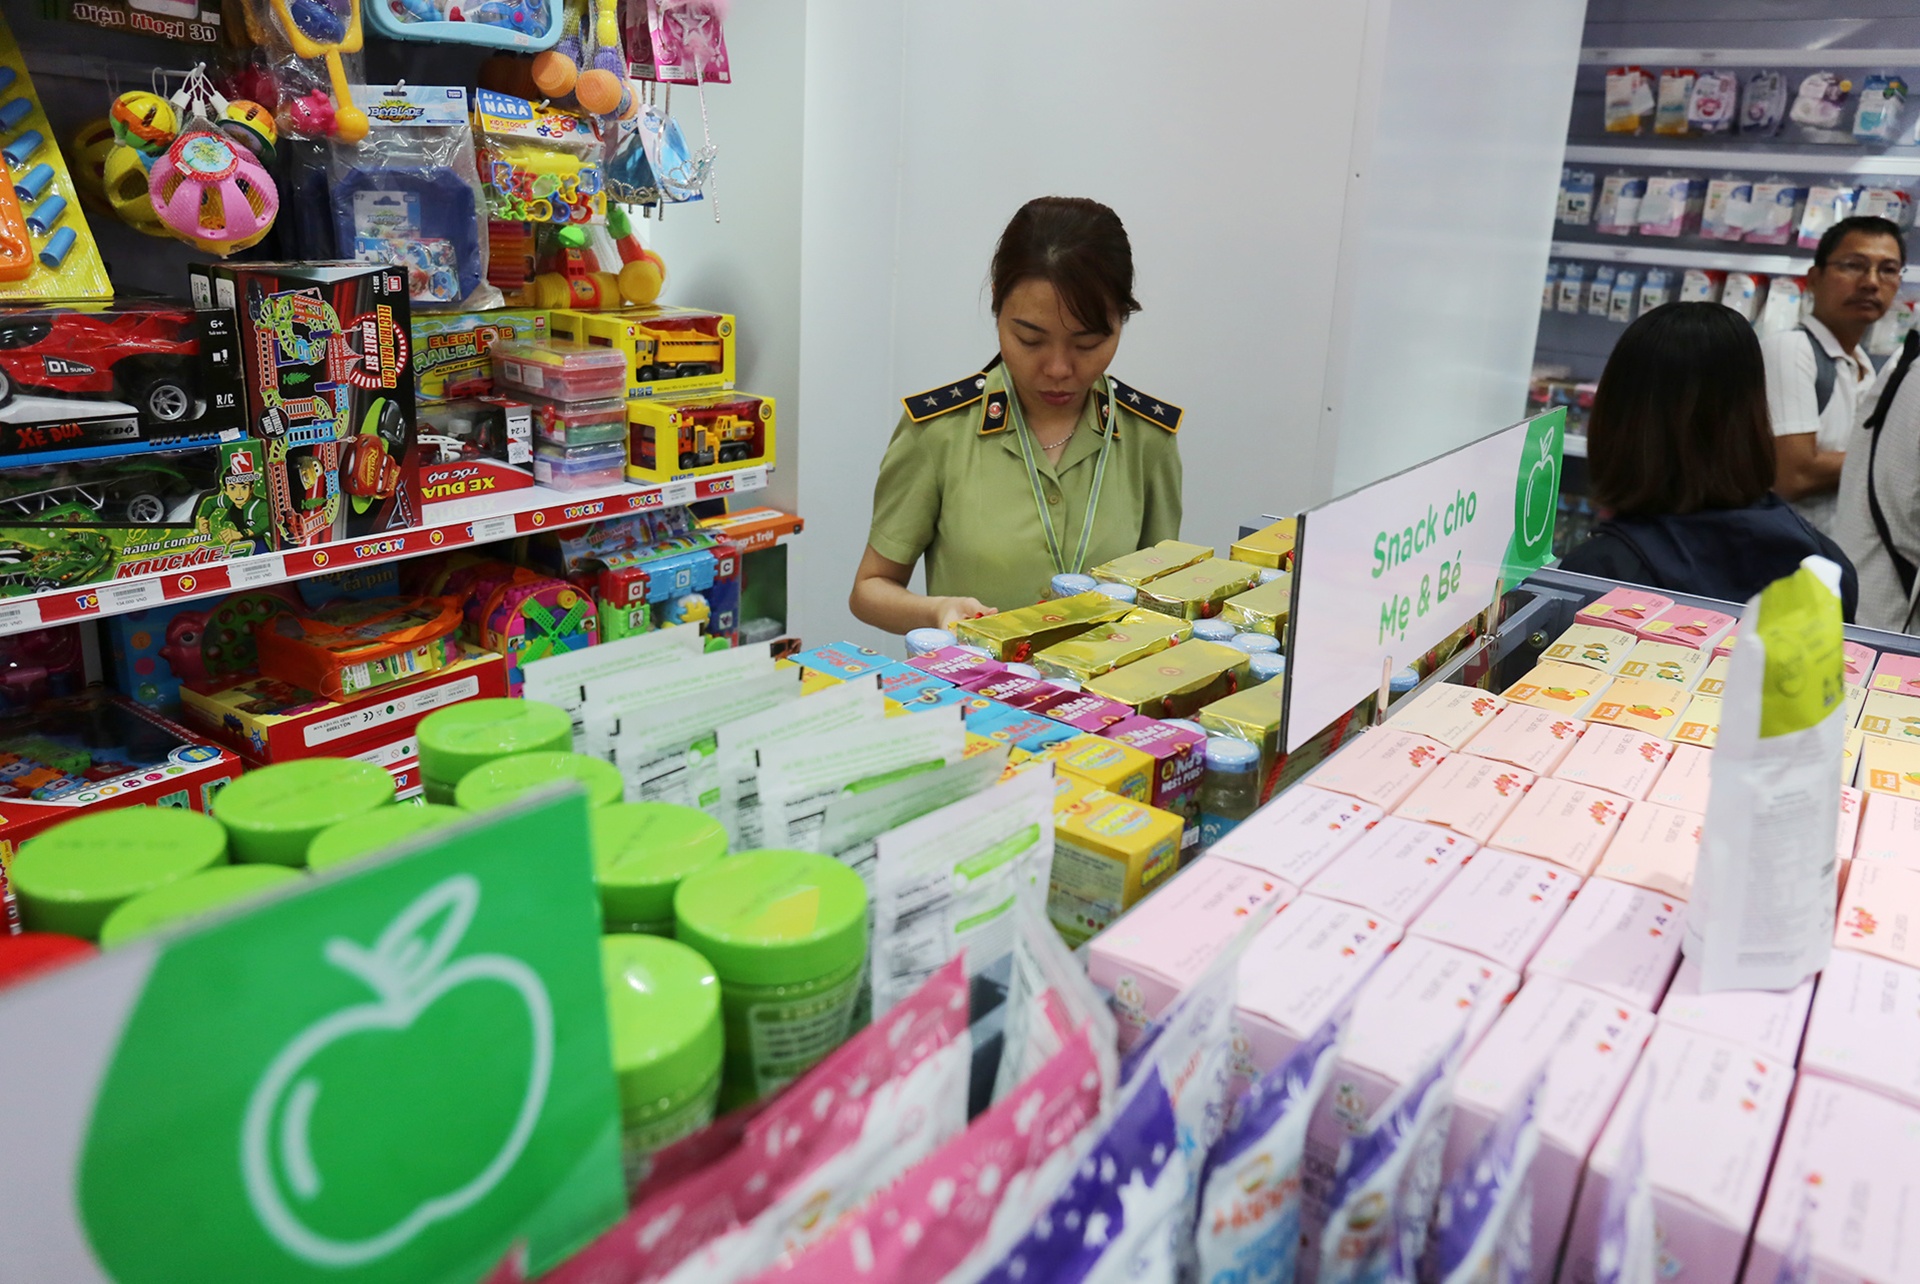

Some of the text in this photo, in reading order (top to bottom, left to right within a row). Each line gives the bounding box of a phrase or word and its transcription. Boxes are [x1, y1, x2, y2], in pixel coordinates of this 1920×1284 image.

[189, 24, 216, 41] 3D
[368, 106, 424, 116] BEYBLADE
[485, 100, 529, 116] NARA
[489, 119, 528, 129] KIDS TOOLS
[210, 320, 224, 329] 6+
[377, 304, 394, 346] ELECTRIC
[362, 321, 379, 371] CREATE SET
[382, 368, 397, 389] CAR
[216, 394, 235, 405] R/C
[16, 427, 47, 449] XE
[511, 426, 527, 435] 1:24
[469, 476, 495, 491] XE
[564, 502, 604, 518] TOYCITY
[1371, 489, 1477, 579] Snack cho
[123, 533, 213, 555] RADIO CONTROL
[355, 538, 405, 558] TOYCITY
[680, 575, 687, 585] b
[632, 585, 640, 595] a
[1378, 550, 1462, 645] Mẹ & Bé
